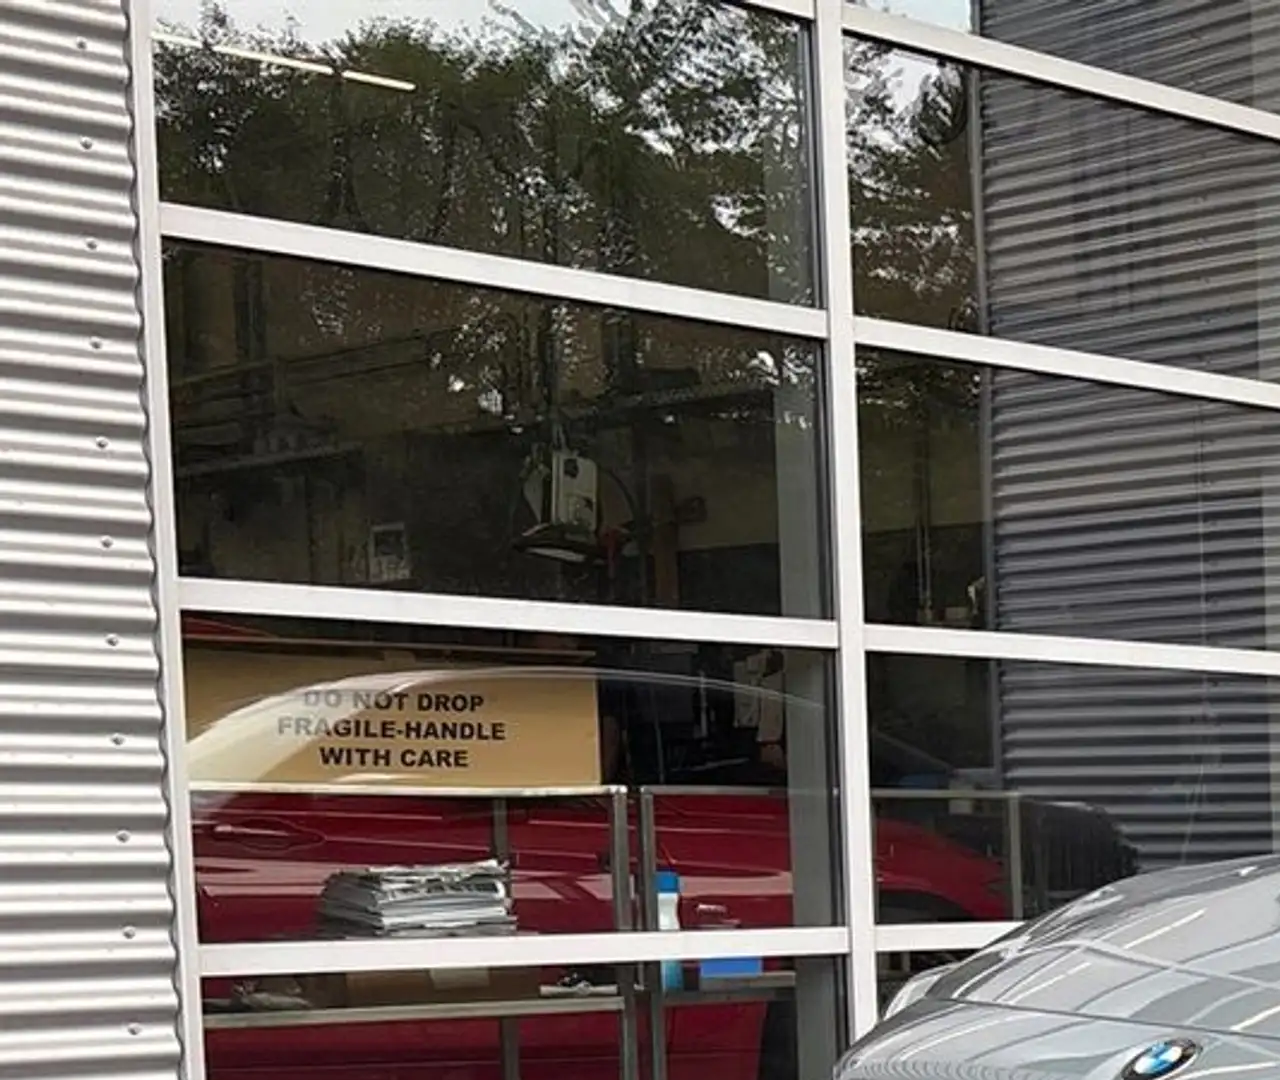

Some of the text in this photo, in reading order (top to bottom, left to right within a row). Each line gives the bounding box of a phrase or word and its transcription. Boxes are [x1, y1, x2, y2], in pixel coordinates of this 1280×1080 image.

[304, 691, 484, 712] DO NOT DROP
[278, 717, 506, 741] FRAGILE-HANDLE
[319, 747, 469, 768] WITH CARE
